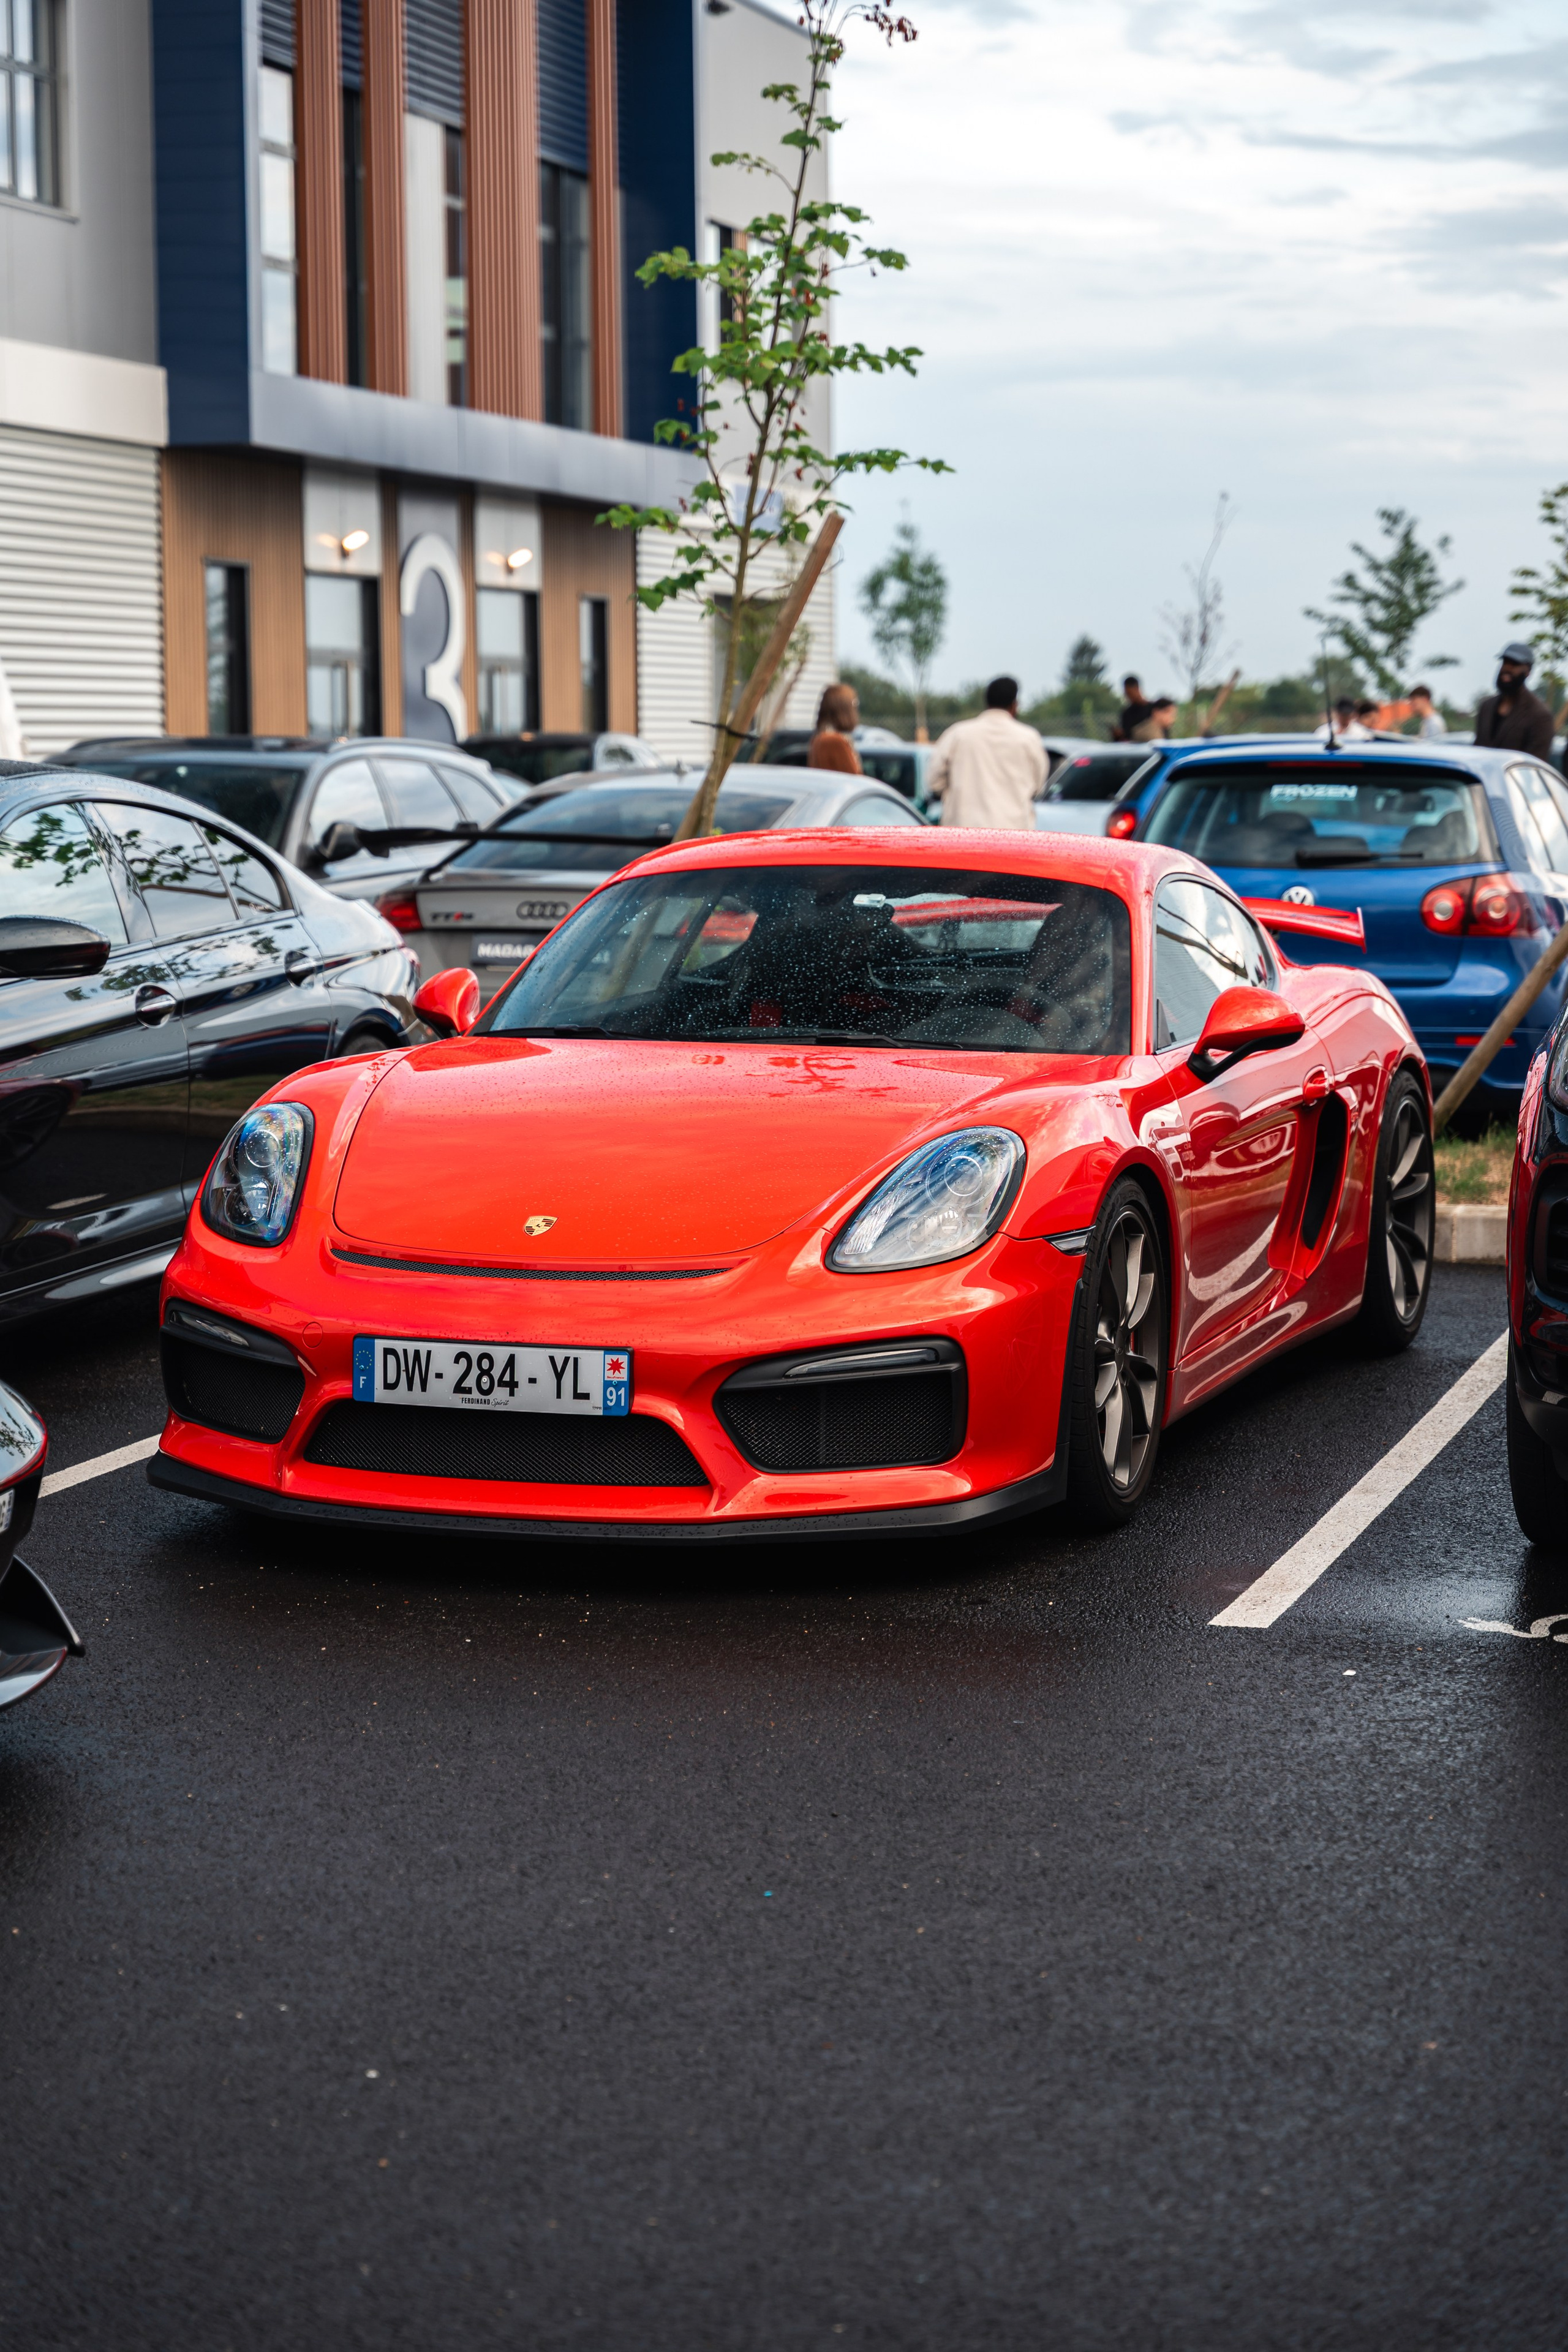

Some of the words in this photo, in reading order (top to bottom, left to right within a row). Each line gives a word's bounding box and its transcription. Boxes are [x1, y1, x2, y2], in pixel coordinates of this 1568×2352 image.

[400, 533, 468, 743] 3
[1270, 784, 1358, 801] FROZEN
[360, 1376, 367, 1388] F
[383, 1348, 590, 1400] DW-284-YL
[491, 1398, 509, 1408] Spirit
[606, 1387, 625, 1406] 91
